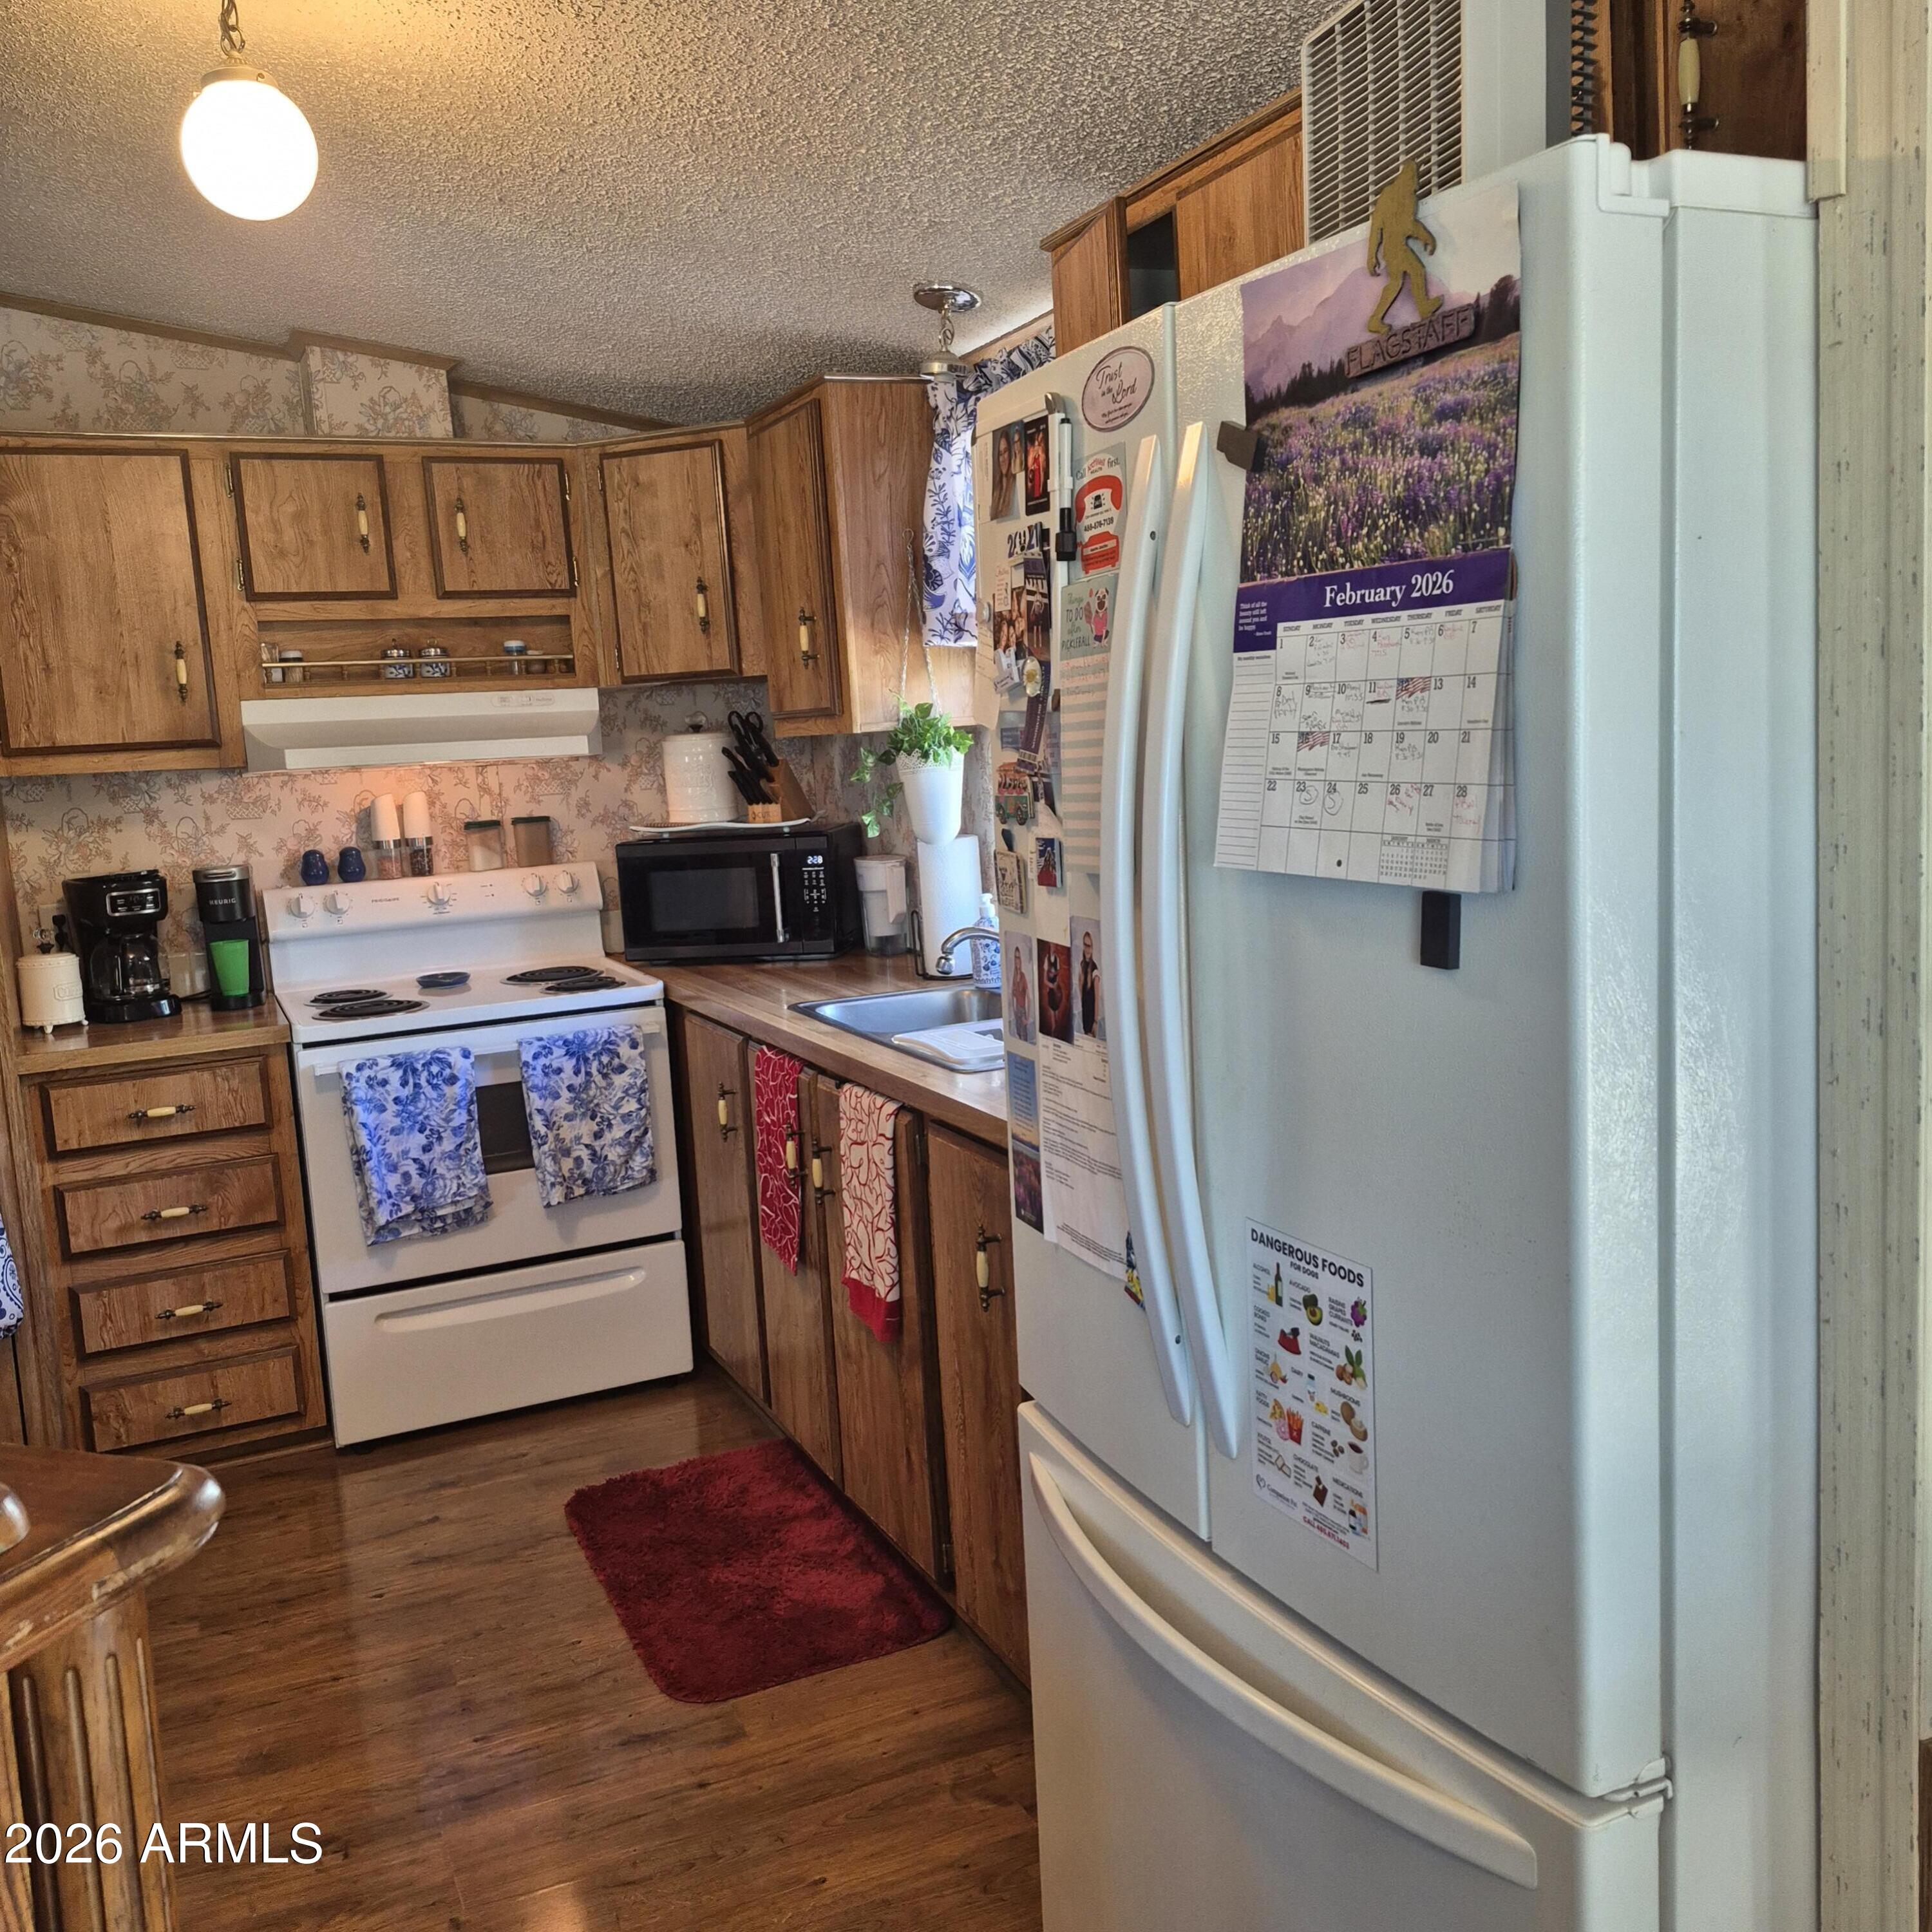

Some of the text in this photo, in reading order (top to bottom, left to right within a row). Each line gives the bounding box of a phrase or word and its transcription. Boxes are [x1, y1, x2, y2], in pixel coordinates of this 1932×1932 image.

[1346, 307, 1471, 376] FLAGSTAFF
[1095, 361, 1122, 390] Trust
[1112, 377, 1137, 404] Lord
[1323, 569, 1455, 607] February 2026
[1066, 607, 1083, 622] TO DO
[1279, 638, 1283, 649] 1
[1309, 636, 1314, 647] 2
[1340, 633, 1346, 645] 3
[1372, 630, 1378, 642] 4
[1404, 627, 1410, 639] 5
[1437, 625, 1444, 637] 6
[1472, 621, 1477, 633] 7
[1276, 686, 1282, 697] 8
[1305, 685, 1311, 696] 9
[1337, 683, 1347, 694] 10
[1368, 681, 1376, 694] 11
[1400, 678, 1410, 692] 12
[1433, 678, 1443, 690] 13
[1466, 676, 1476, 688] 14
[1271, 731, 1470, 744] 15 16 17 18 19 20 21
[1267, 780, 1468, 798] 22 23 24 25 26 27 28
[209, 897, 237, 905] KEURIG
[1251, 1227, 1364, 1288] DANGEROUS FOODS
[1290, 1261, 1319, 1279] FOR DOGS
[1302, 1515, 1316, 1528] CALL
